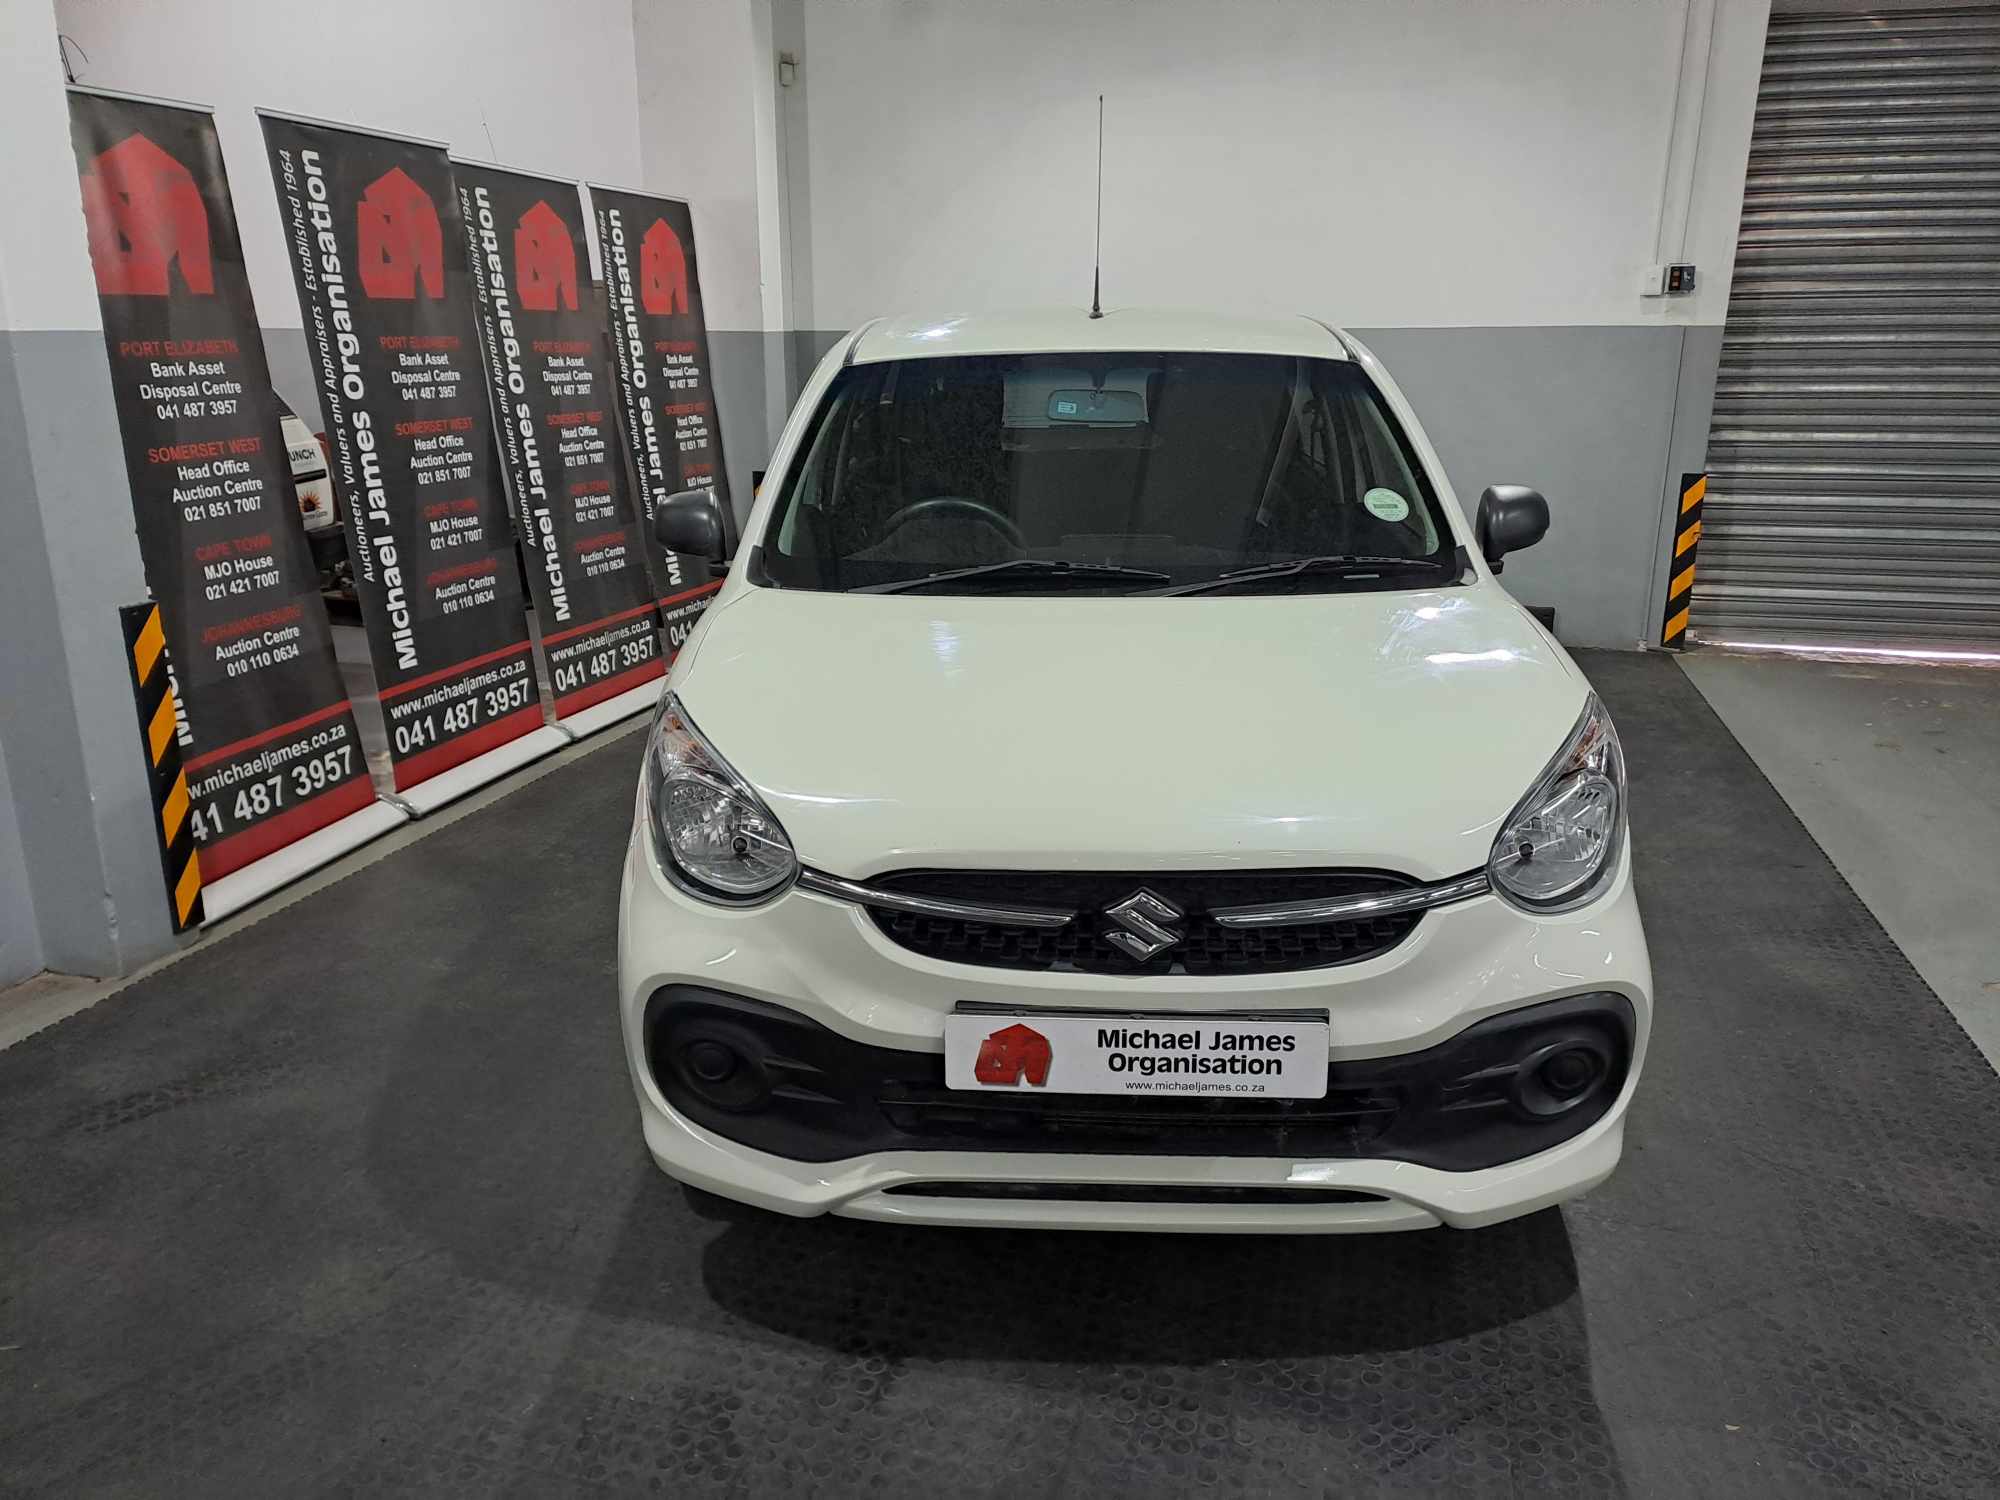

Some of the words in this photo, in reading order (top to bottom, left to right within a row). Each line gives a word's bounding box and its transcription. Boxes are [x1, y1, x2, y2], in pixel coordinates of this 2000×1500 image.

[279, 149, 298, 190] 1964
[460, 187, 472, 221] 1964
[288, 195, 318, 291] Established
[301, 150, 365, 400] Organisation
[466, 224, 488, 303] Established
[475, 187, 525, 394] Organisation
[609, 209, 647, 389] Organisation
[120, 341, 160, 356] PORT
[312, 305, 337, 388] Appraisers
[399, 353, 423, 366] Bank
[425, 353, 449, 365] Asset
[484, 313, 504, 387] Appraisers
[614, 320, 631, 381] Appraisers
[150, 362, 186, 378] Bank
[188, 361, 225, 376] Asset
[391, 370, 432, 385] Disposal
[433, 370, 460, 381] Centre
[140, 382, 199, 401] Disposal
[202, 381, 242, 395] Centre
[329, 390, 343, 424] and
[401, 388, 418, 400] 041
[420, 387, 436, 399] 487
[438, 386, 456, 398] 3957
[495, 389, 509, 415] and
[622, 383, 633, 406] and
[157, 404, 180, 420] 041
[183, 402, 205, 418] 487
[209, 400, 237, 415] 3957
[414, 438, 437, 451] Head
[439, 435, 464, 448] Office
[504, 416, 519, 464] Valuers
[628, 407, 641, 450] Valuers
[639, 396, 663, 480] James
[148, 441, 224, 463] SOMERSET
[229, 438, 262, 454] WEST
[336, 427, 355, 485] Valuers
[410, 455, 444, 469] Auction
[446, 451, 473, 464] Centre
[517, 403, 546, 500] James
[559, 442, 583, 454] Auction
[177, 463, 210, 480] Head
[213, 460, 250, 476] Office
[352, 410, 390, 525] James
[418, 472, 433, 485] 021
[435, 469, 451, 483] 851
[452, 466, 471, 480] 7007
[173, 485, 221, 503] Auction
[224, 479, 263, 494] Centre
[184, 505, 206, 522] 021
[209, 501, 231, 518] 851
[234, 496, 260, 513] 7007
[430, 519, 449, 533] MJO
[450, 516, 478, 529] House
[515, 470, 536, 547] Auctioneers,
[350, 490, 375, 582] Auctioneers,
[430, 536, 445, 550] 021
[447, 533, 461, 546] 421
[464, 528, 482, 543] 7007
[204, 561, 232, 580] MJO
[234, 555, 273, 574] House
[534, 508, 570, 622] Michael
[581, 551, 604, 564] Auction
[205, 583, 227, 601] 021
[230, 578, 251, 594] 421
[253, 570, 280, 589] 7007
[372, 535, 418, 670] Michael
[435, 583, 468, 600] Auction
[468, 576, 496, 590] Centre
[442, 599, 458, 614] 010
[459, 595, 473, 609] 110
[474, 590, 495, 605] 0634
[215, 638, 262, 661] Auction
[263, 627, 300, 646] Centre
[551, 620, 650, 662] www.michaeljames.co.za
[226, 659, 248, 678] 010
[250, 652, 271, 670] 110
[273, 643, 299, 663] 0634
[555, 661, 586, 691] 041
[590, 649, 616, 678] 487
[620, 635, 653, 666] 3957
[391, 660, 526, 720] www.michaeljames.co.za
[395, 715, 436, 754] 041
[443, 697, 478, 733] 487
[485, 678, 529, 717] 3957
[234, 775, 283, 821] 487
[292, 745, 351, 796] 3957
[1097, 1029, 1200, 1050] Michael
[1209, 1032, 1296, 1051] James
[1108, 1053, 1283, 1076] Organisation
[1125, 1081, 1265, 1093] www.michaeljames.co.za
